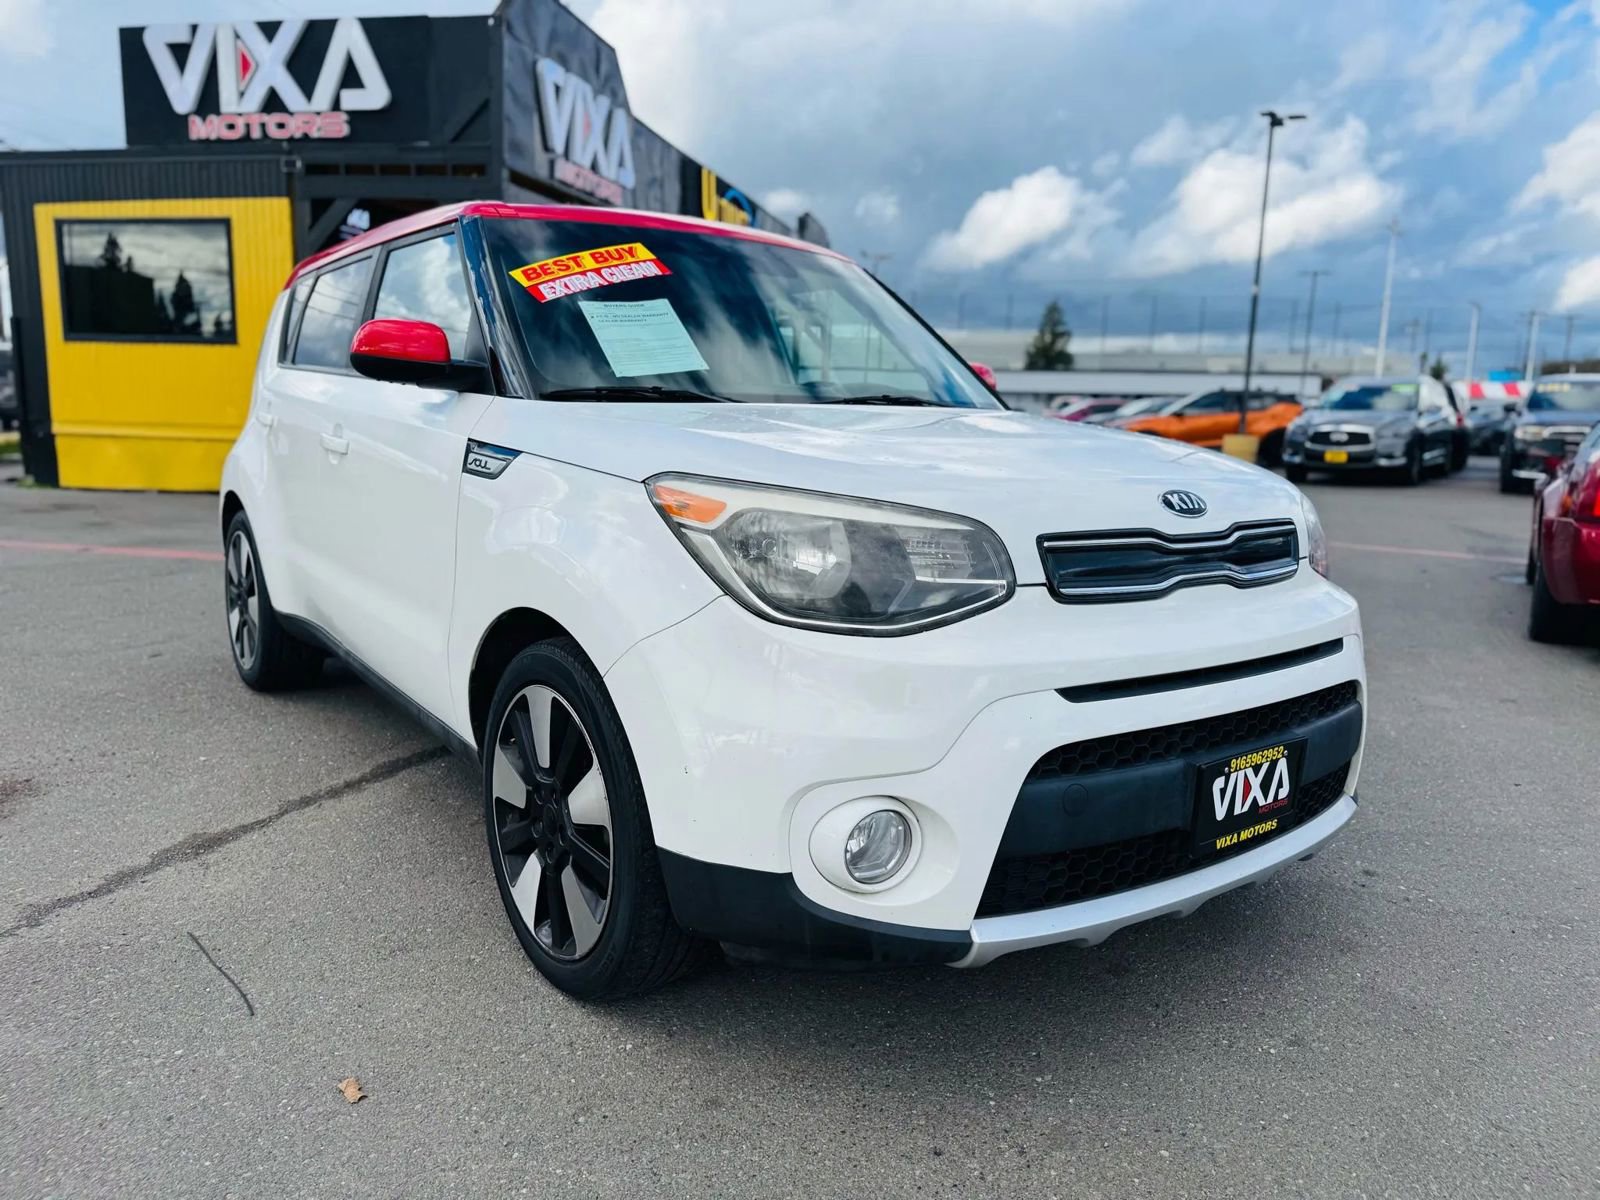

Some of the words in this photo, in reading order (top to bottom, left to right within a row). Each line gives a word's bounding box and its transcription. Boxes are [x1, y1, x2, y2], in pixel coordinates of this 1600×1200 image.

[142, 18, 392, 115] VIXA
[187, 111, 349, 141] MOTORS
[535, 57, 636, 190] VIXA
[520, 255, 585, 282] BEST
[588, 246, 637, 265] BUY
[538, 270, 609, 300] EXTRA
[600, 260, 663, 286] CLEAN
[1164, 493, 1206, 510] KIA
[1230, 745, 1285, 772] 9165962952
[1212, 757, 1290, 822] VIXA
[1258, 799, 1289, 815] MOTORS
[1215, 833, 1238, 850] VIXA
[1239, 819, 1278, 841] MOTORS
